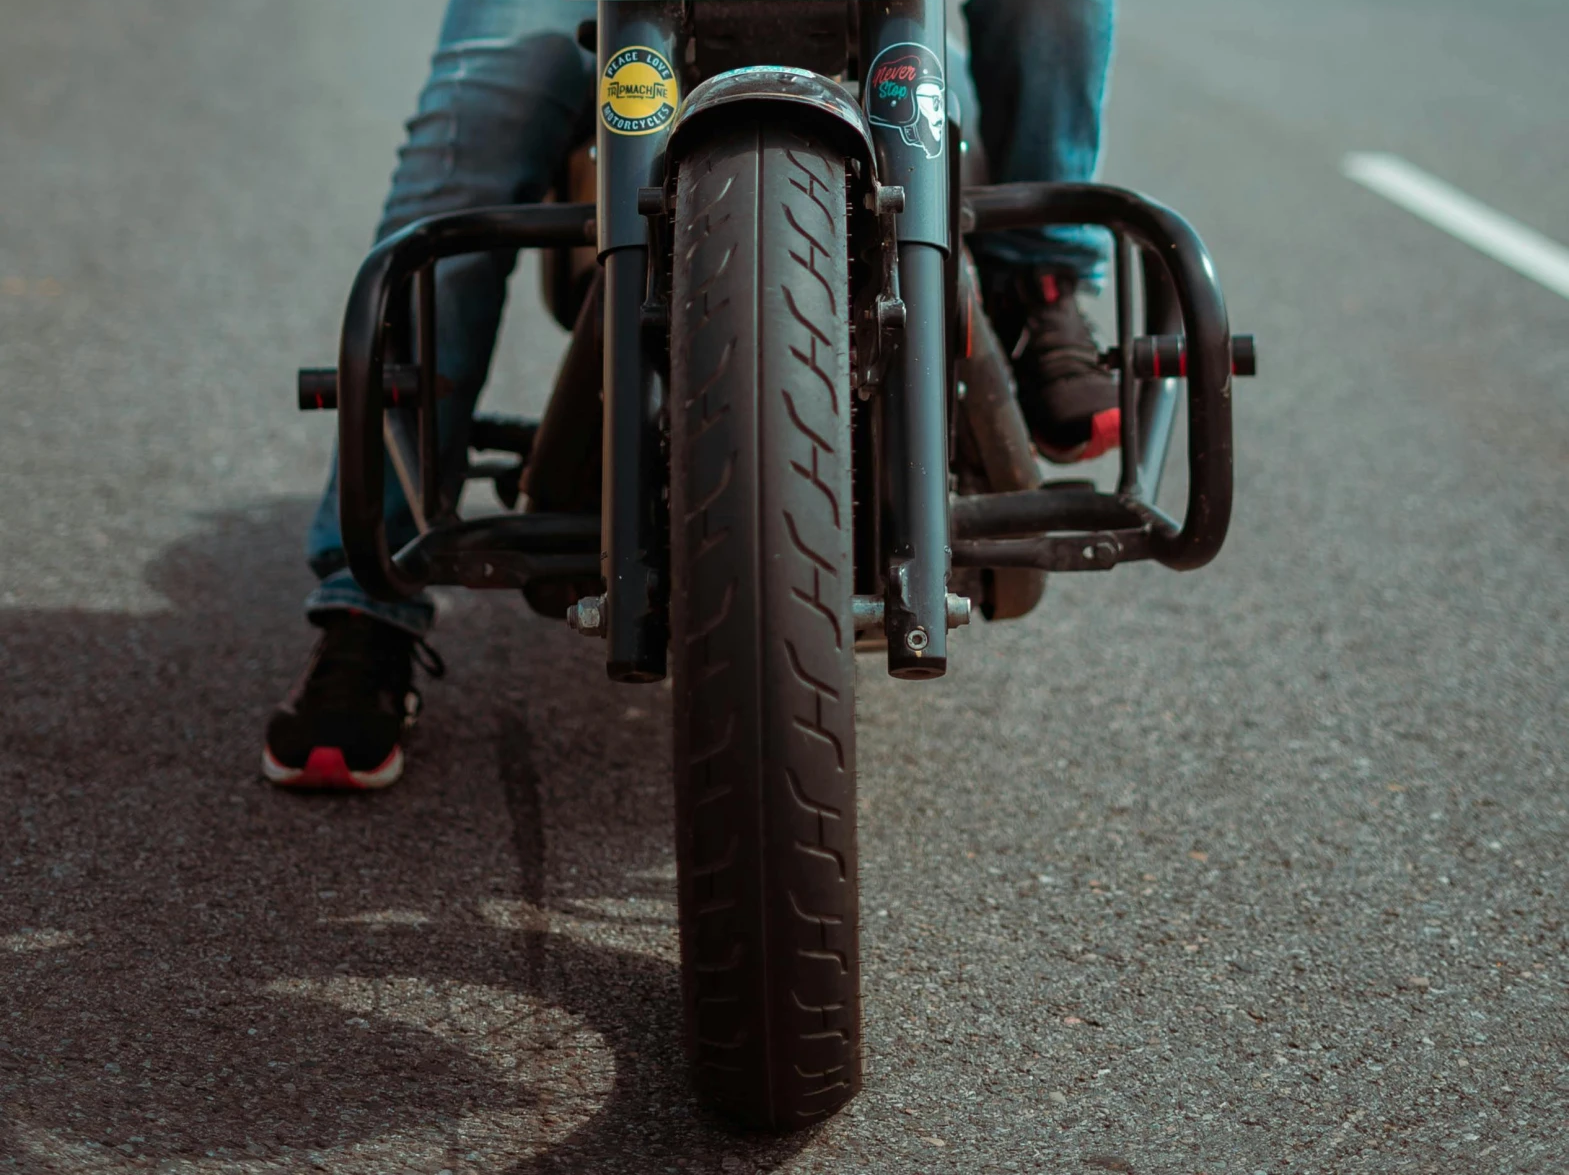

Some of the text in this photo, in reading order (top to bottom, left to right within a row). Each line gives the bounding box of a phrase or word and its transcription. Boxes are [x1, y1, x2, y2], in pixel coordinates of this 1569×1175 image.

[607, 52, 670, 77] PEACE LOVE
[603, 106, 670, 130] MOTORCYCLES
